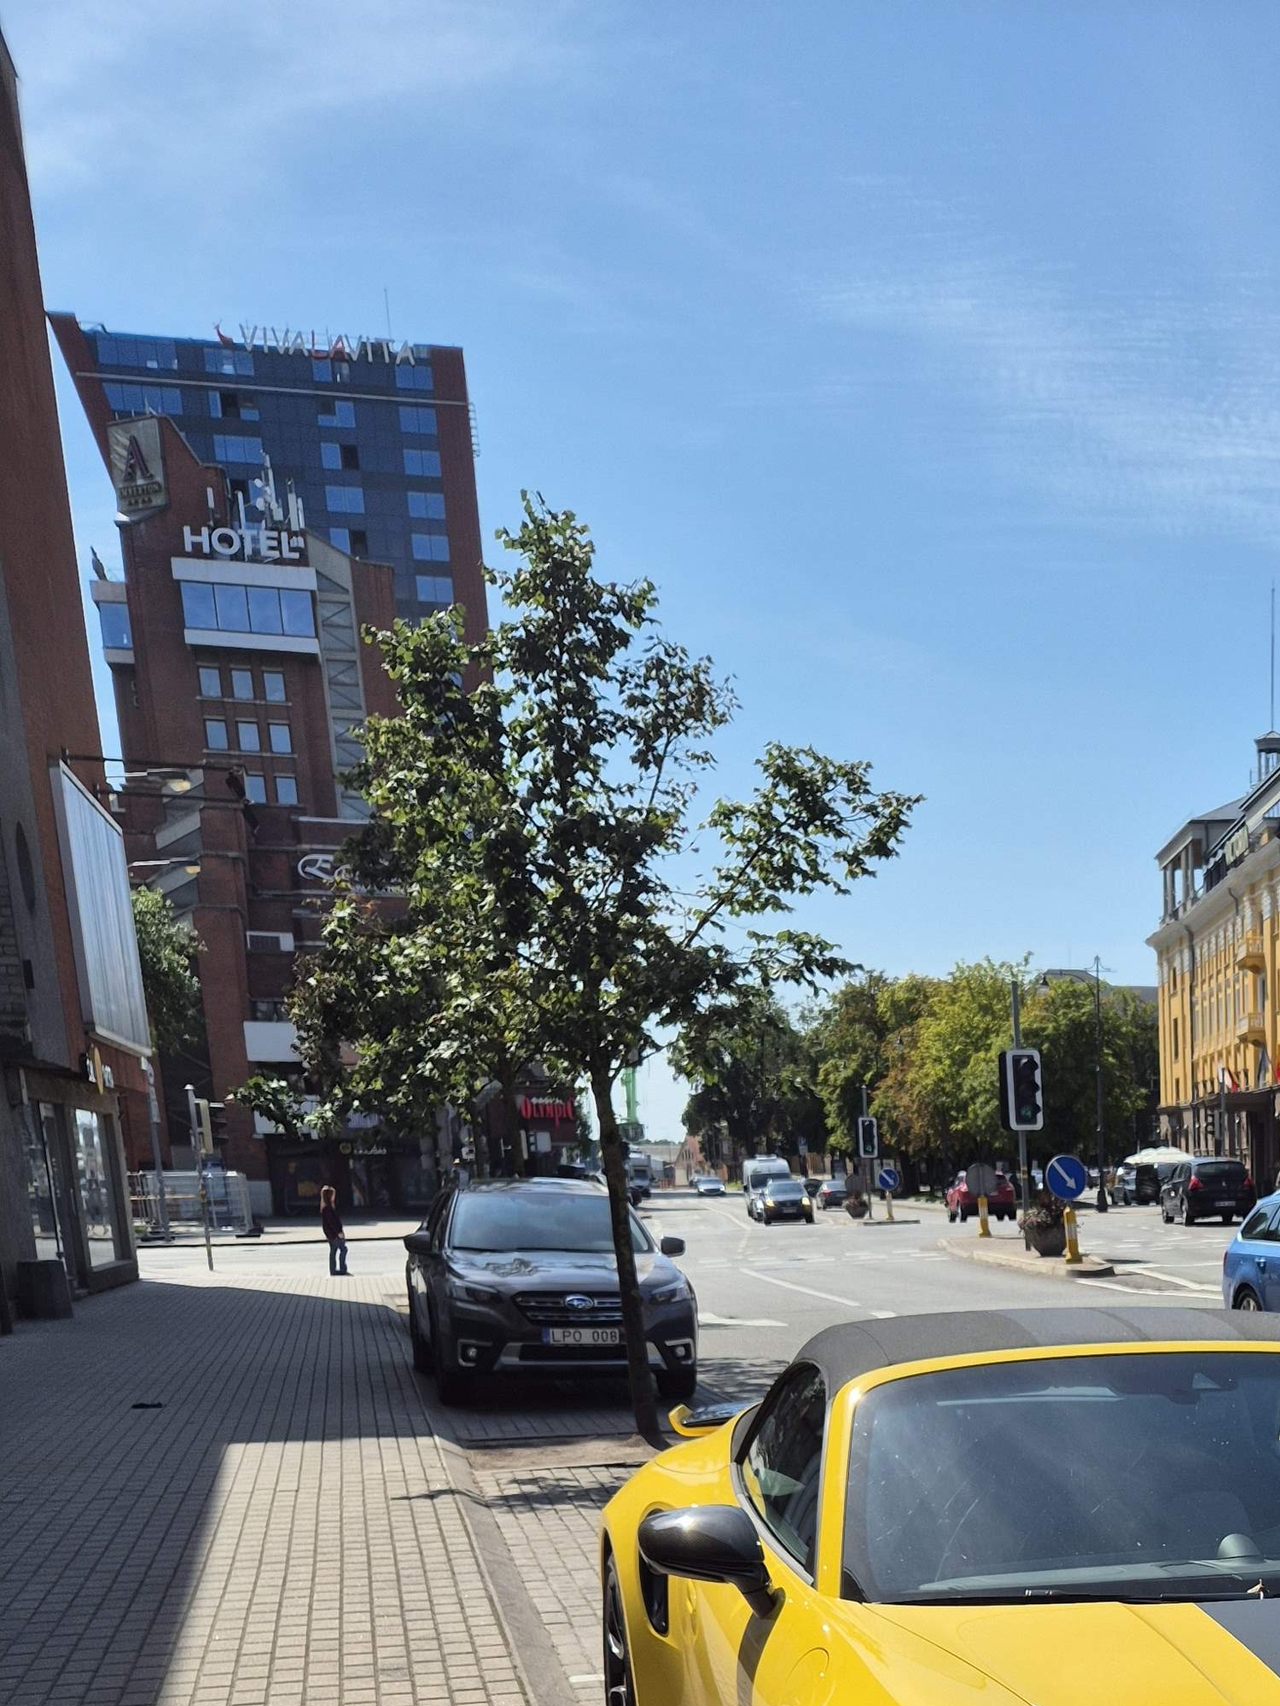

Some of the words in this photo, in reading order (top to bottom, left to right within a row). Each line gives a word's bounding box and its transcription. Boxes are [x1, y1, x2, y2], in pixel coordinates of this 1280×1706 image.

[183, 525, 300, 559] HOTEL
[552, 1330, 582, 1343] LPO
[592, 1330, 618, 1343] 008
